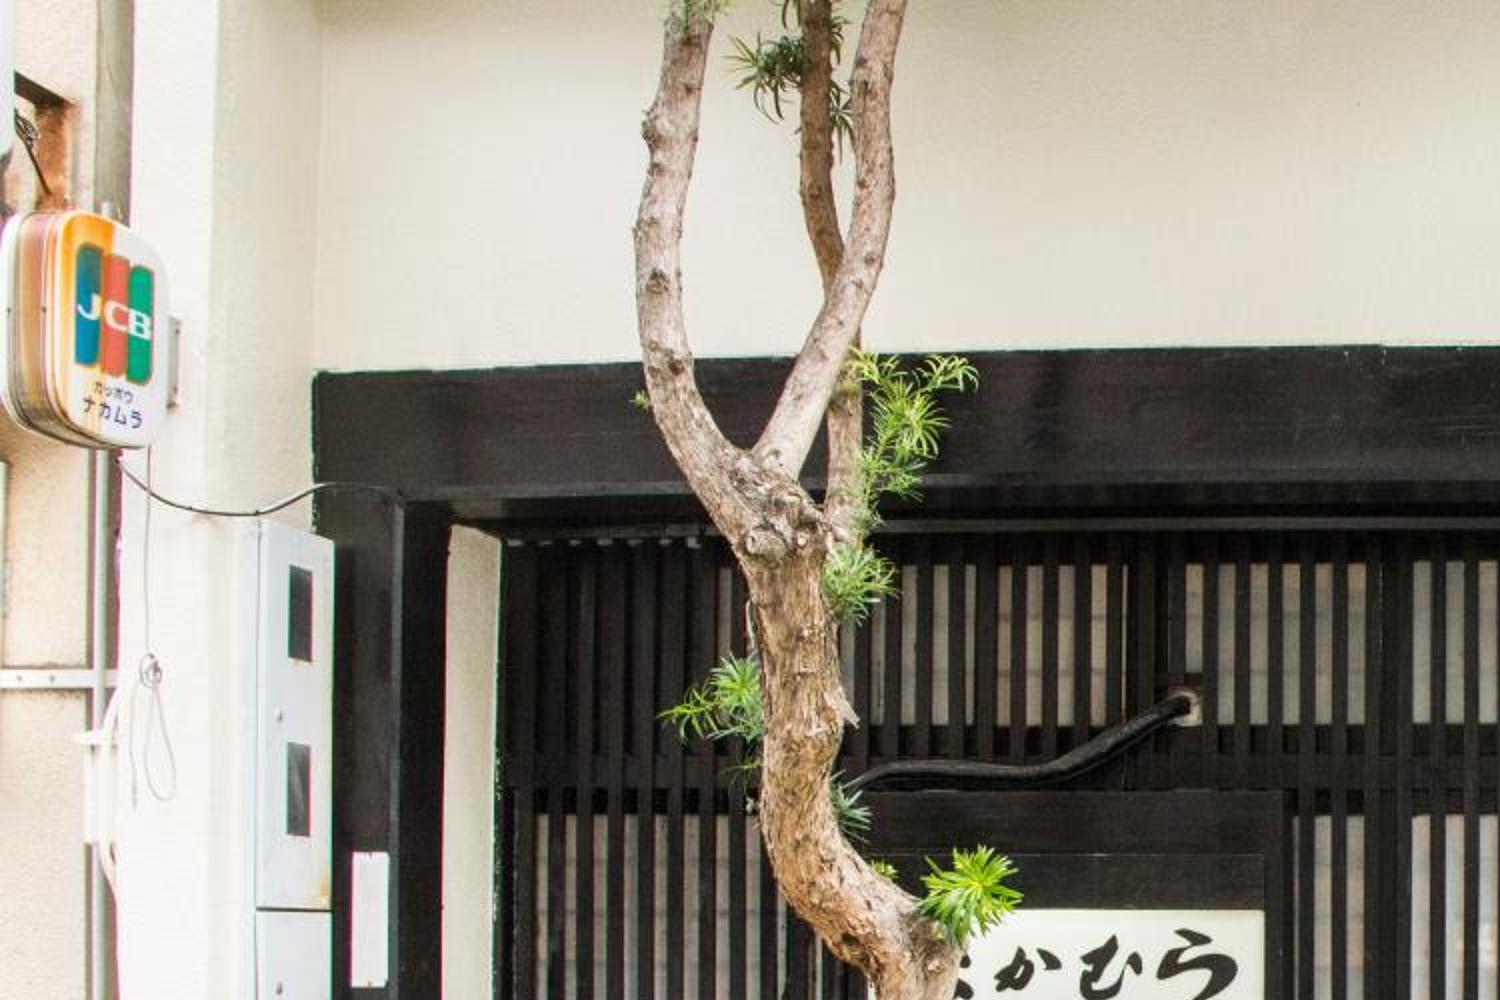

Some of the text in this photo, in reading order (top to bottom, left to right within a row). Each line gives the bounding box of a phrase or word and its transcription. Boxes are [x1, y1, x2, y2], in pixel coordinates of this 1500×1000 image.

[77, 293, 152, 341] JCB
[83, 395, 143, 429] ナカムラ
